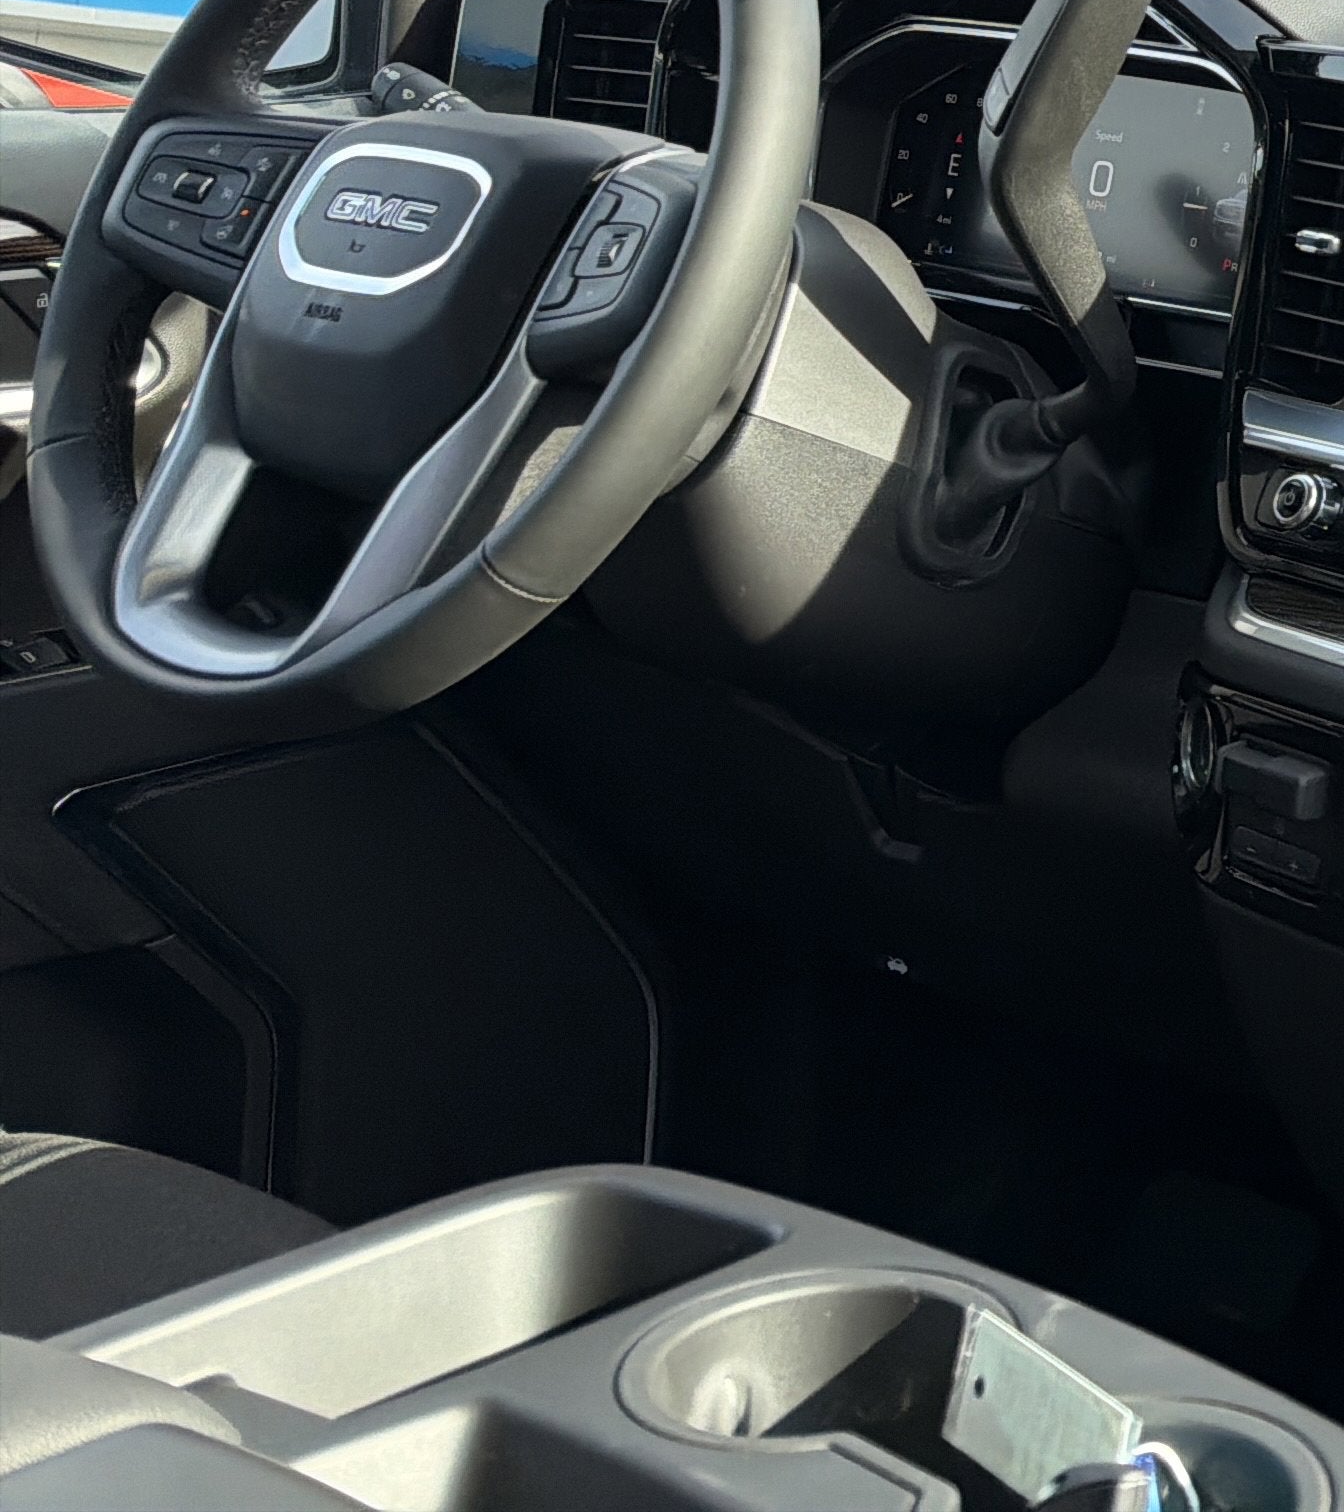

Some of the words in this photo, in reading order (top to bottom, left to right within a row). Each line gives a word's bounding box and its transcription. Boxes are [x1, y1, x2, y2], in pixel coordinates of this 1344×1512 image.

[945, 93, 958, 105] 60
[1222, 141, 1231, 154] 2
[897, 149, 910, 161] 20
[947, 153, 962, 177] E
[1089, 160, 1114, 198] 0
[326, 190, 439, 233] GMC
[1086, 199, 1107, 212] MPH
[1222, 258, 1232, 271] P
